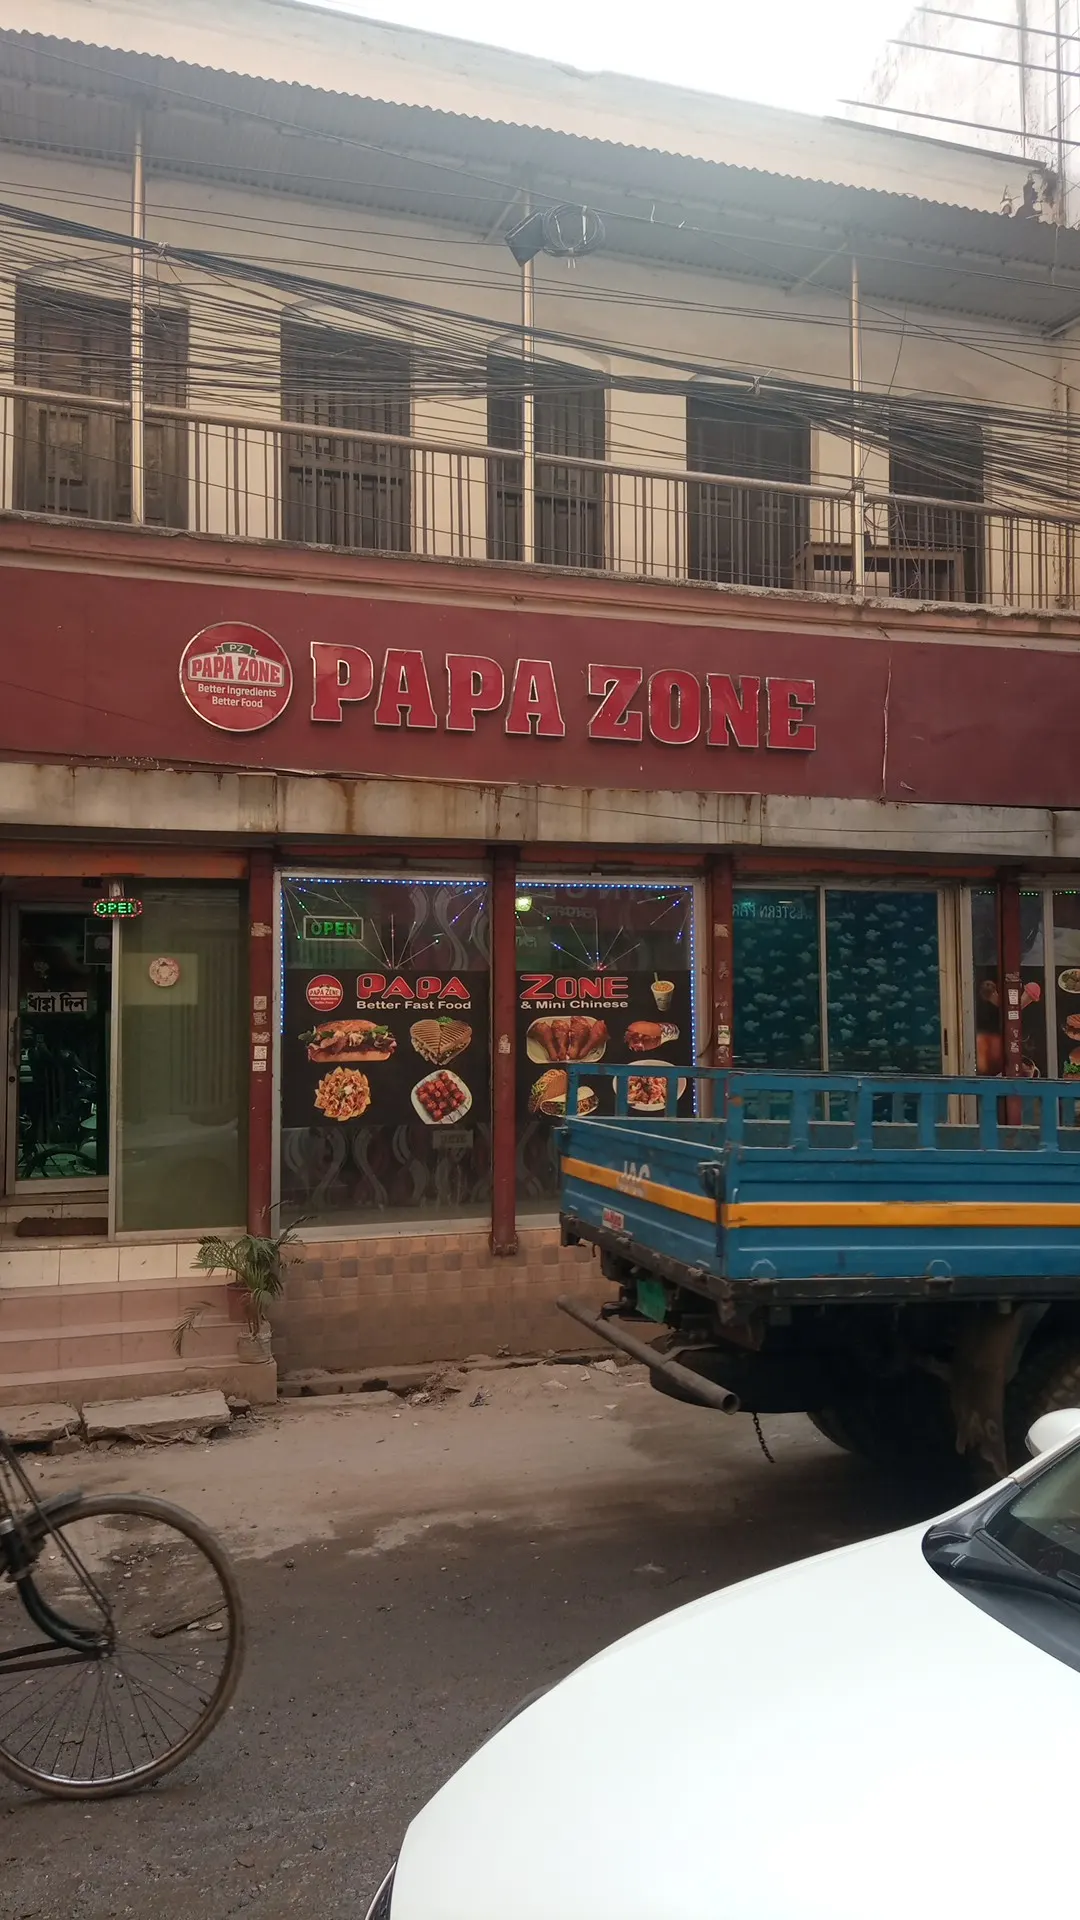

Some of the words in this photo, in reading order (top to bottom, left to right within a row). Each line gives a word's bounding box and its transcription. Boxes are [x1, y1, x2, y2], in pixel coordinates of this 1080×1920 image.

[229, 644, 244, 652] PZ
[191, 655, 234, 680] PAPA
[238, 656, 281, 684] ZONE
[198, 683, 227, 694] Better
[227, 685, 277, 698] Ingredients
[310, 641, 566, 737] PAPA
[587, 663, 817, 750] ZONE
[212, 696, 239, 707] Better
[241, 697, 263, 708] Food
[96, 902, 137, 913] OPEN
[311, 921, 357, 936] OPEN
[356, 973, 471, 999] PAPA
[519, 974, 629, 999] ZONE
[59, 992, 88, 1011] দিন
[356, 1001, 400, 1010] Better
[404, 1001, 435, 1010] Fast
[438, 1001, 471, 1010] Food
[520, 1001, 532, 1009] &
[536, 1000, 566, 1009] Mini
[569, 1000, 629, 1009] Chinese
